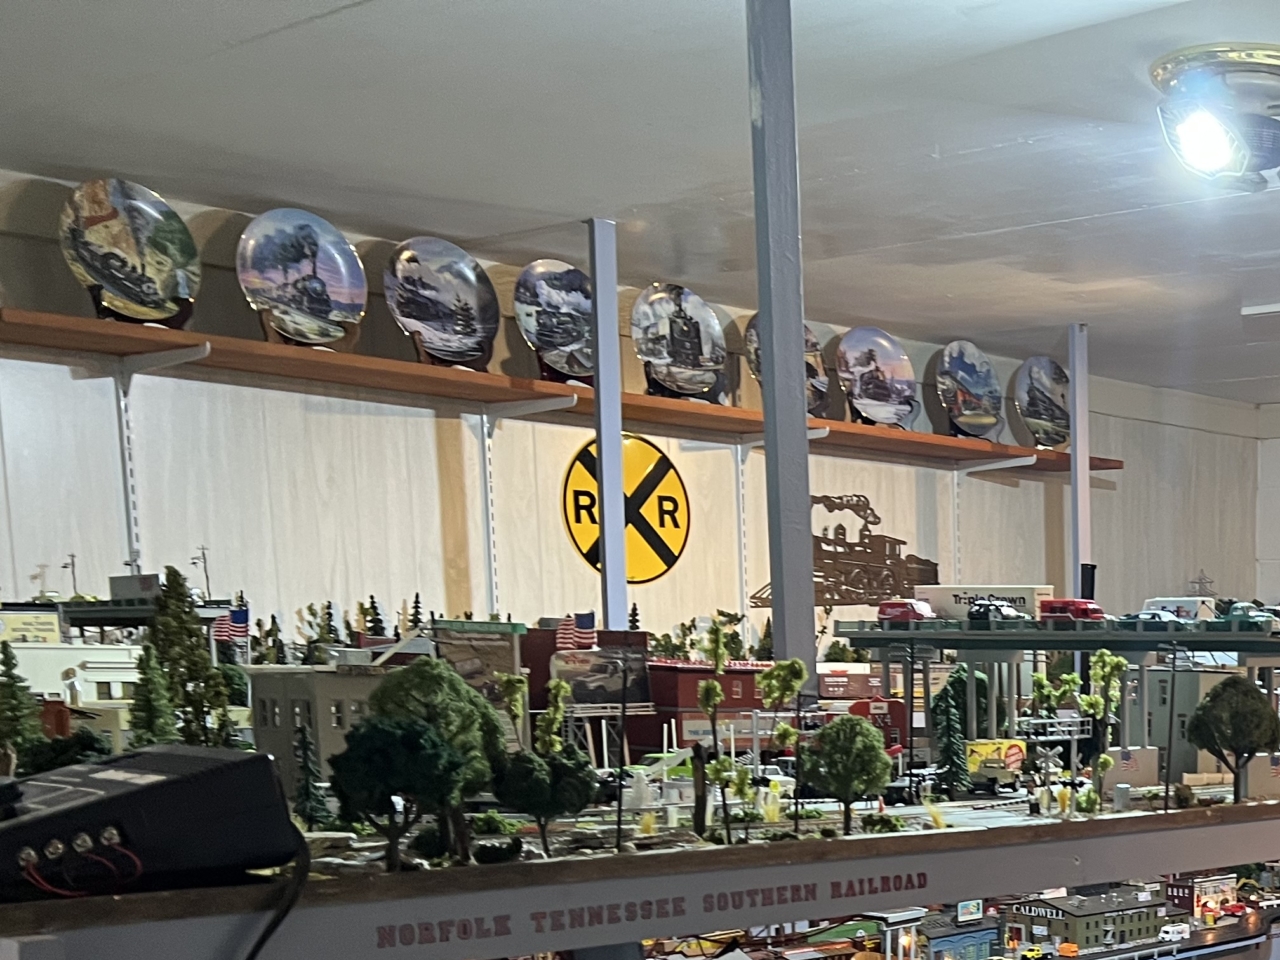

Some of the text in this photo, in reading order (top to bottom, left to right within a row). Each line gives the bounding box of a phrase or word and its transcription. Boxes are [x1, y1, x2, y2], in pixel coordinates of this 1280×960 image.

[573, 490, 681, 529] R R
[376, 871, 929, 949] NORFOLK TENNESSEE SOUTHERN RAILROAD
[1012, 904, 1066, 920] CALDWELL
